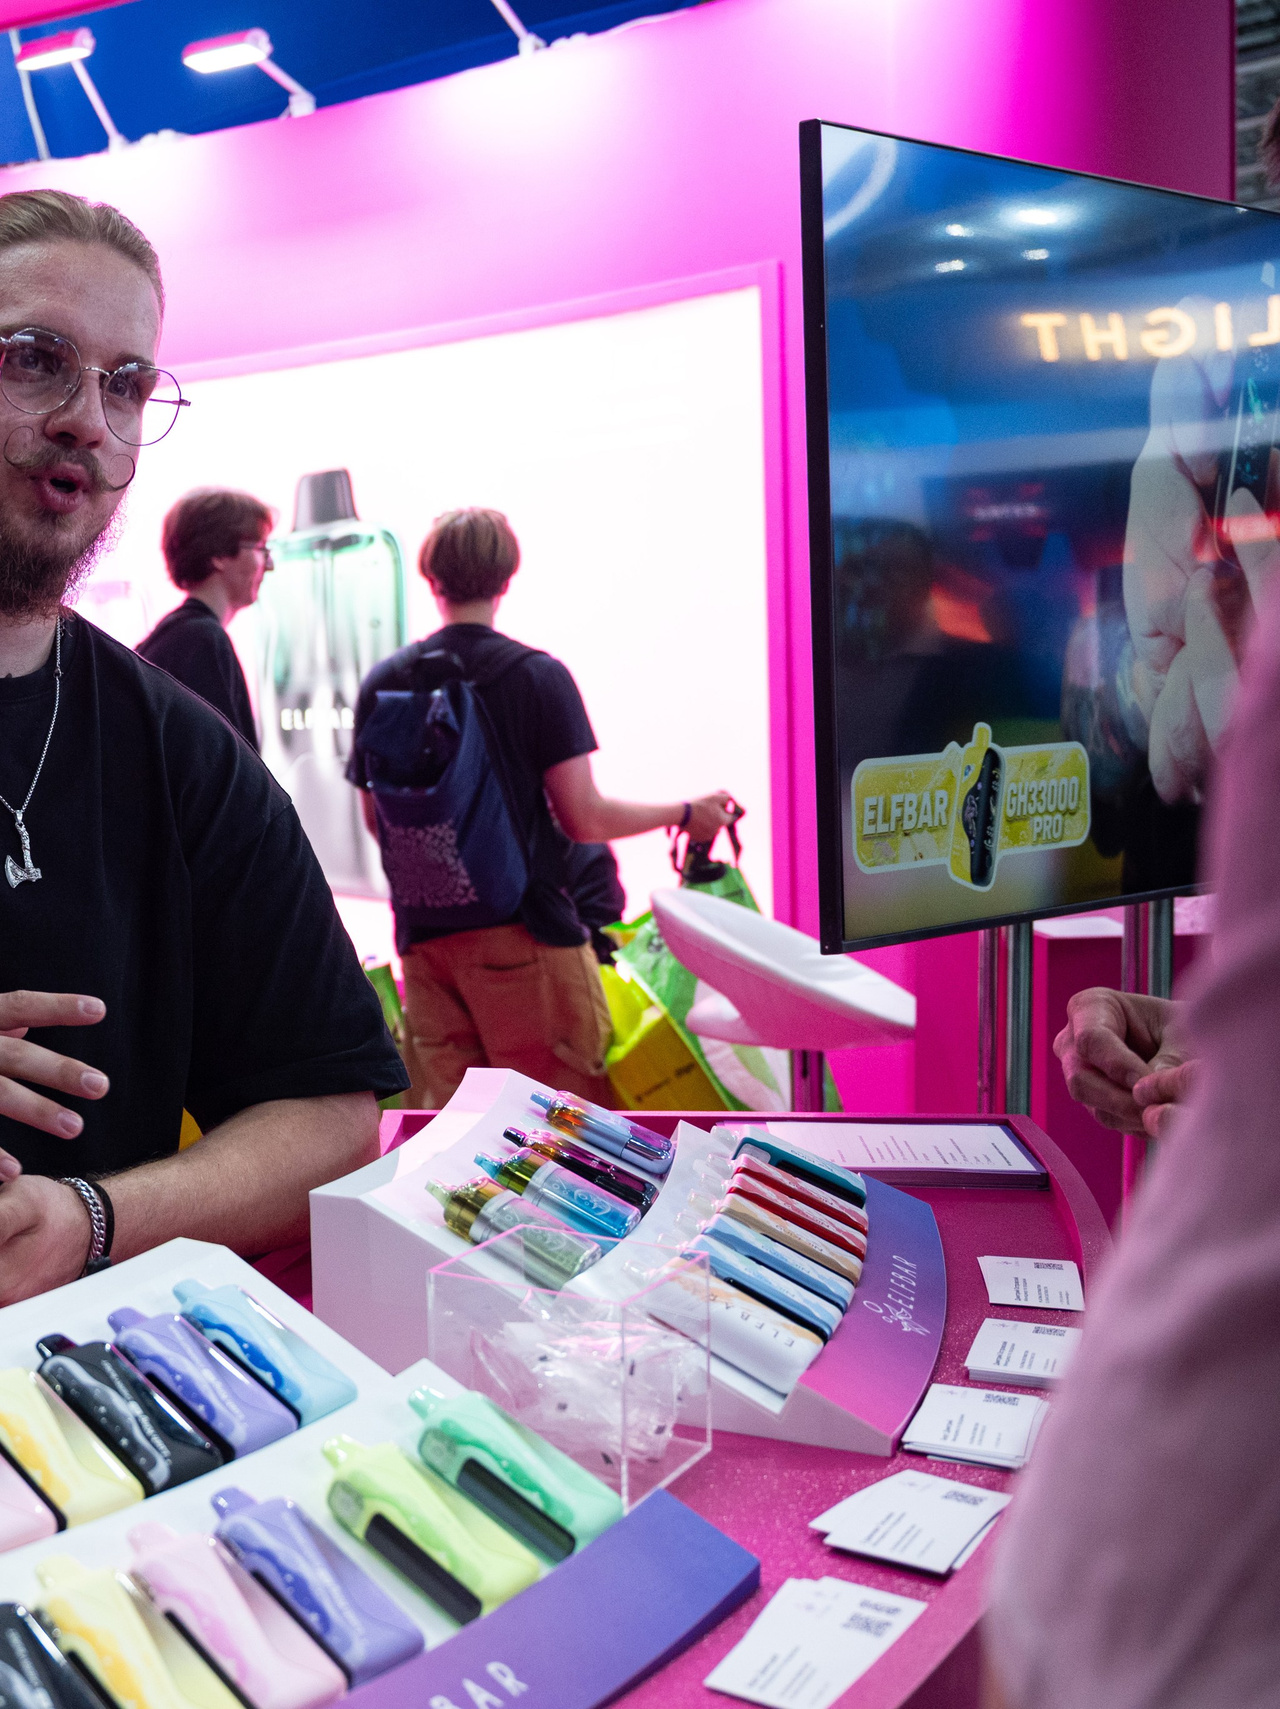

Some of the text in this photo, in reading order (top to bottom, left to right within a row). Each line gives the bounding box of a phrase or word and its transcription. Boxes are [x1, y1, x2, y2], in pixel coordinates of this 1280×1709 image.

[862, 789, 950, 837] ELFBAR
[1006, 776, 1079, 818] GH33000
[1033, 815, 1063, 841] PRO
[887, 1255, 917, 1310] ELFBAR
